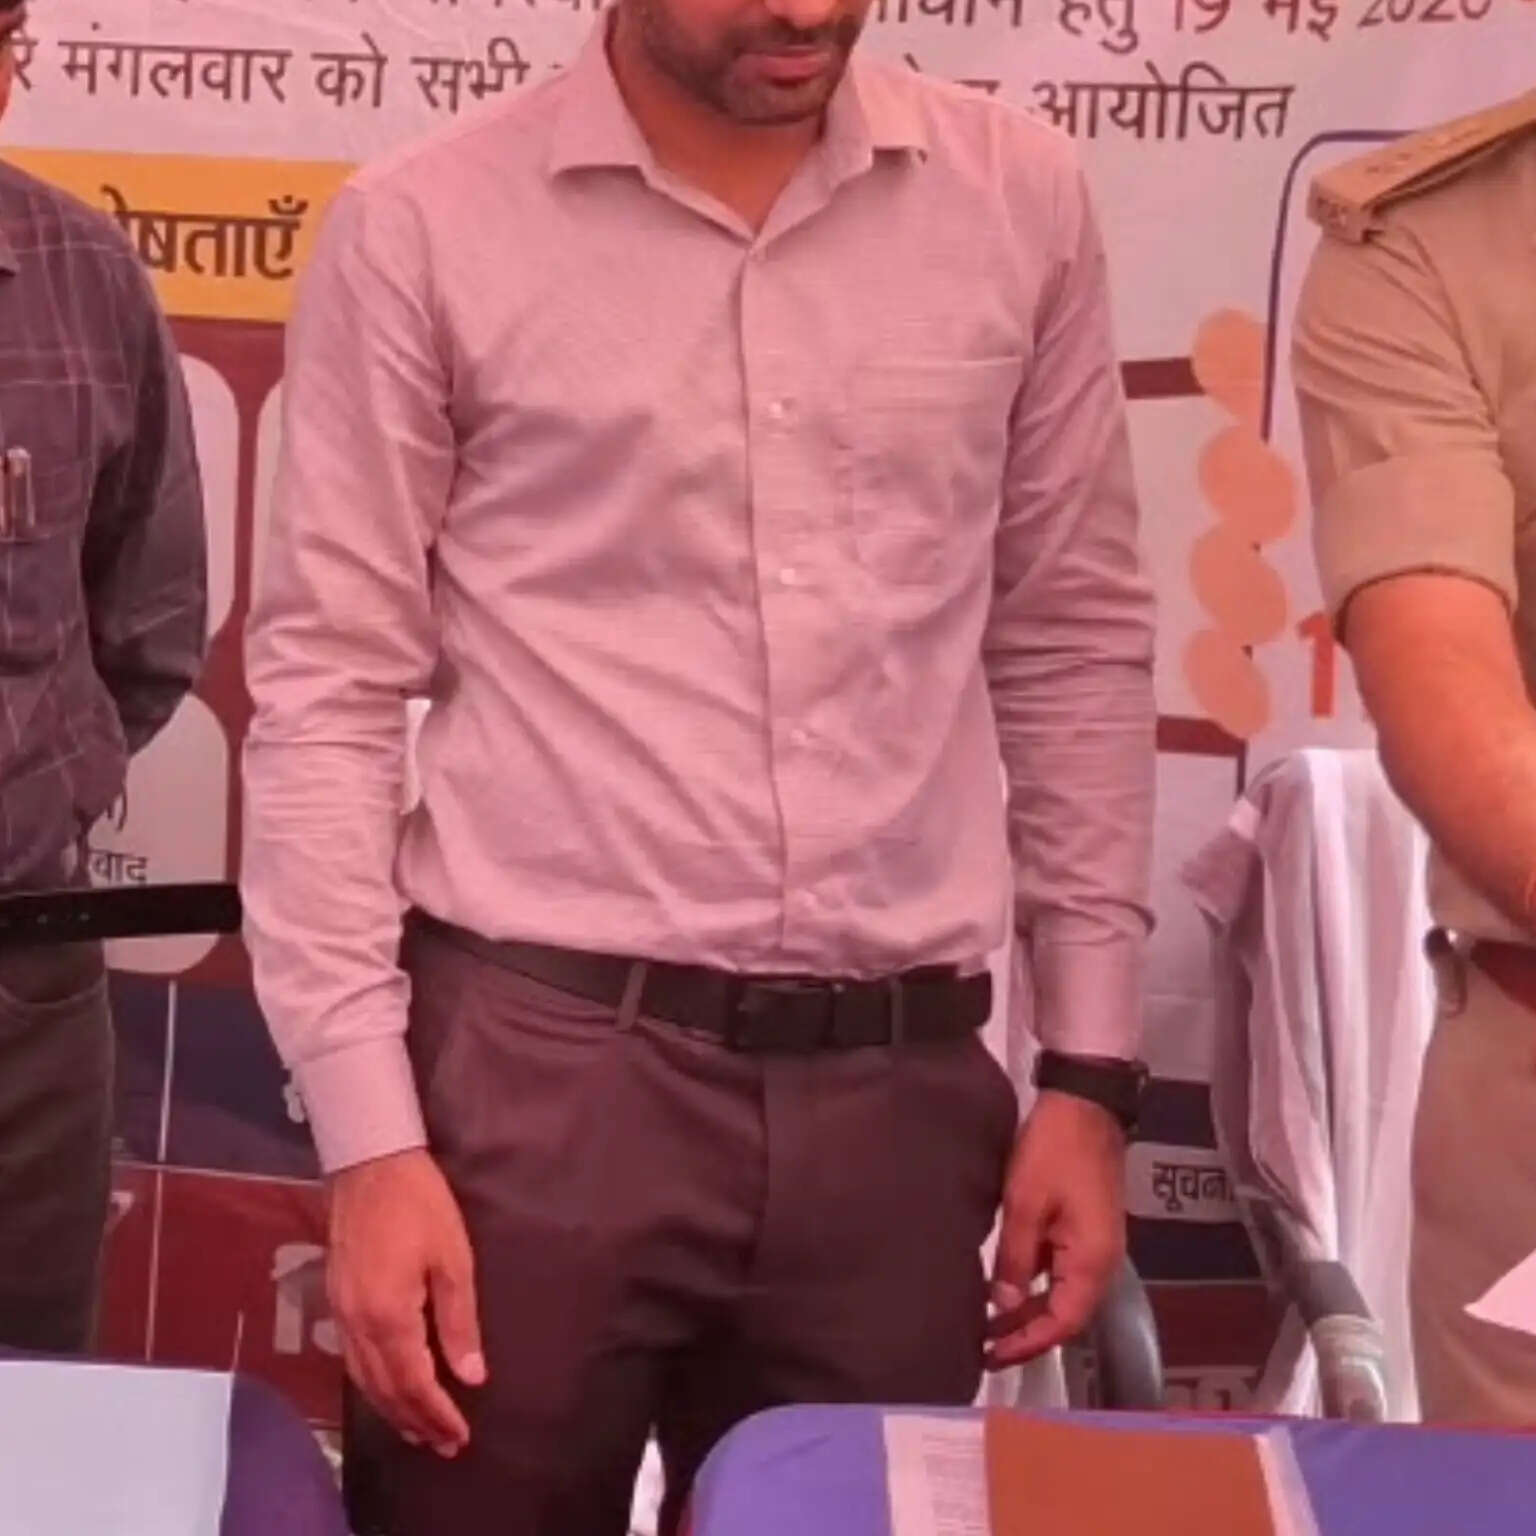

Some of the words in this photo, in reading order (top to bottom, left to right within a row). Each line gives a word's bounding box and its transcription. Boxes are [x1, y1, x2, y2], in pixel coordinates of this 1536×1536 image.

[56, 20, 294, 104] मंगलवार
[309, 31, 390, 110] को
[408, 33, 533, 116] सभी
[1032, 56, 1298, 144] आयोजित
